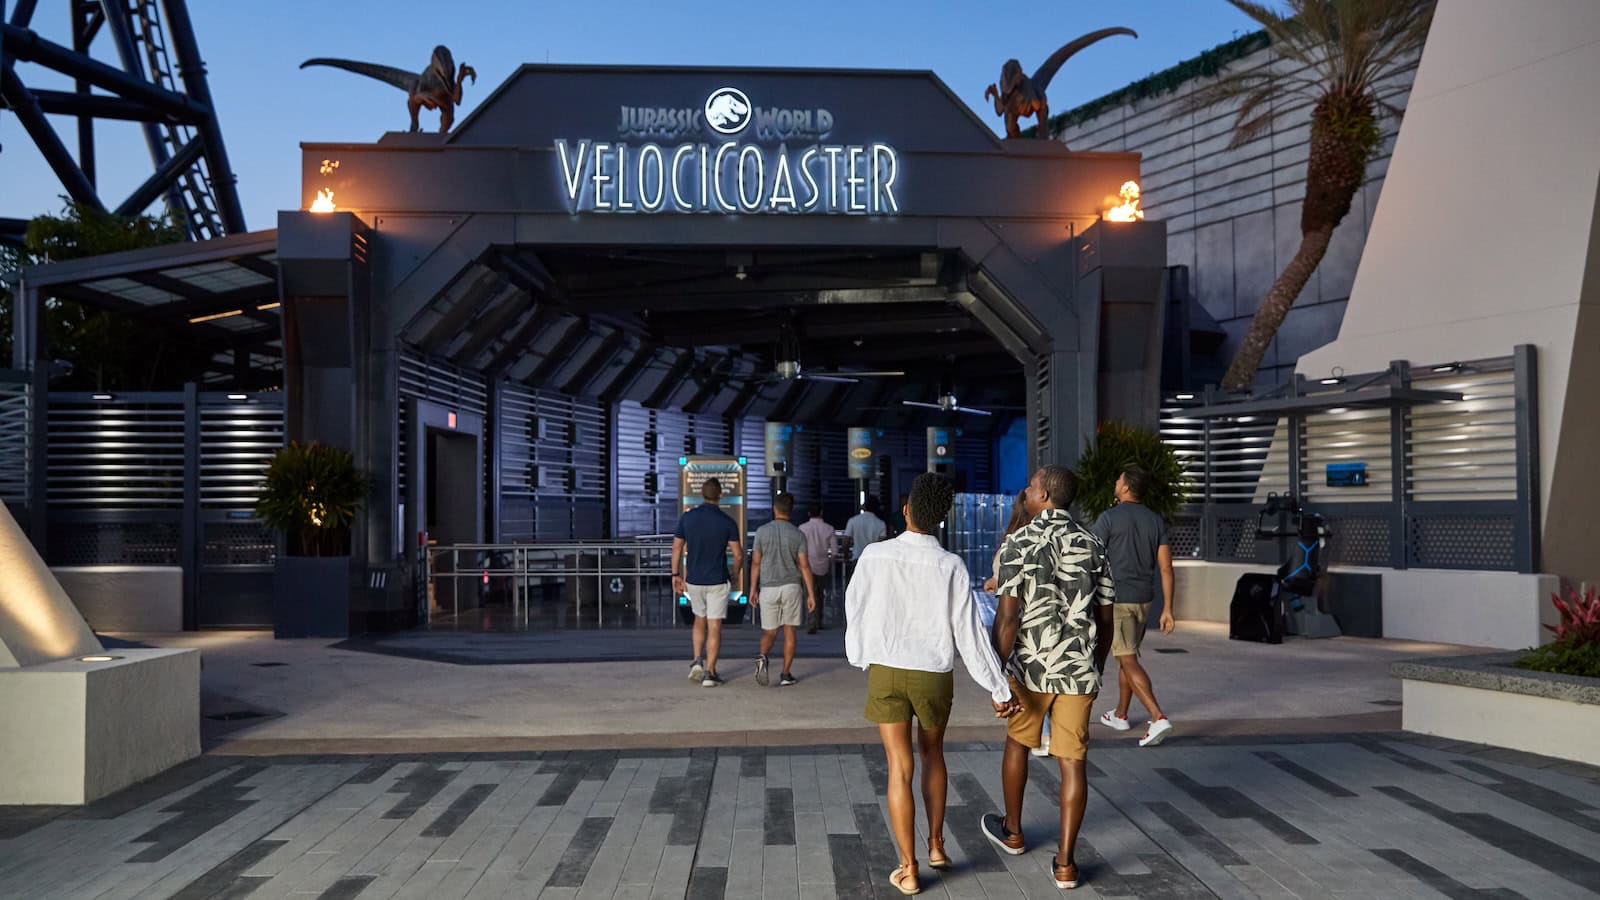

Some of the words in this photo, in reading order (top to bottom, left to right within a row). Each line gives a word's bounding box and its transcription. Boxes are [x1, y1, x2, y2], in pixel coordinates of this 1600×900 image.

[617, 105, 702, 134] JURASSIC
[754, 106, 834, 137] WORLD
[554, 140, 899, 213] VELOCICOASTER
